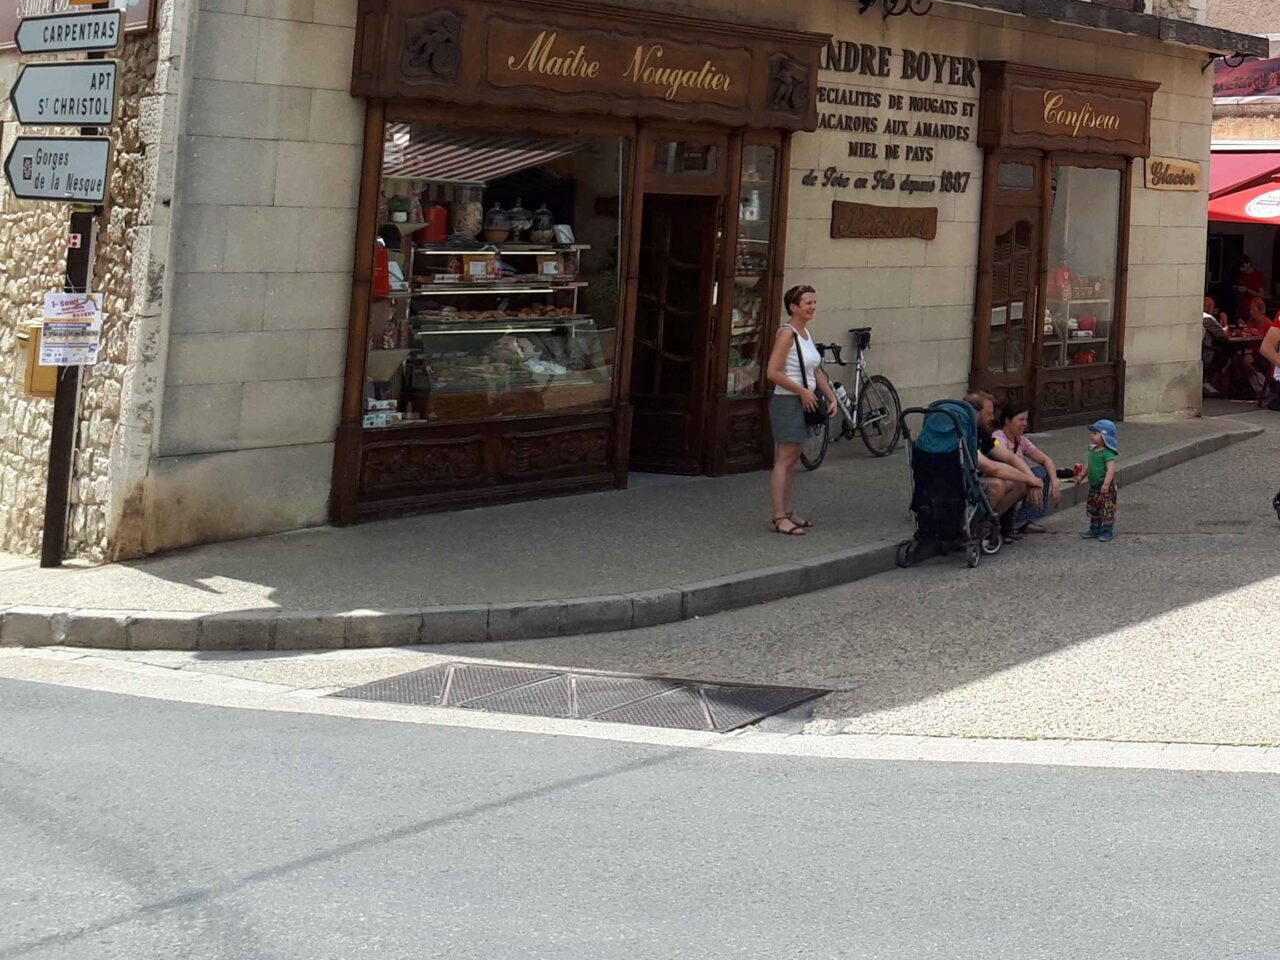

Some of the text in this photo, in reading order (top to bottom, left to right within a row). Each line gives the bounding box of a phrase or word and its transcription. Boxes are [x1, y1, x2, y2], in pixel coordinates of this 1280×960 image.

[43, 21, 115, 43] CARPENTRAS
[507, 30, 731, 100] Maître Nougatier
[900, 48, 976, 88] BOYER
[90, 72, 111, 90] APT
[53, 97, 108, 116] CHRISTOL
[888, 94, 904, 110] DE
[909, 96, 958, 116] NOUGATS
[961, 102, 975, 117] ET
[1044, 91, 1120, 137] Confiseur
[883, 118, 909, 136] AUX
[913, 121, 970, 141] AMANDES
[36, 148, 69, 170] Gorges
[848, 141, 934, 162] MIEL DE PAYS
[34, 172, 102, 196] de la Nesque
[802, 169, 818, 187] de
[939, 170, 972, 193] 1887
[1151, 162, 1195, 186] Glacier
